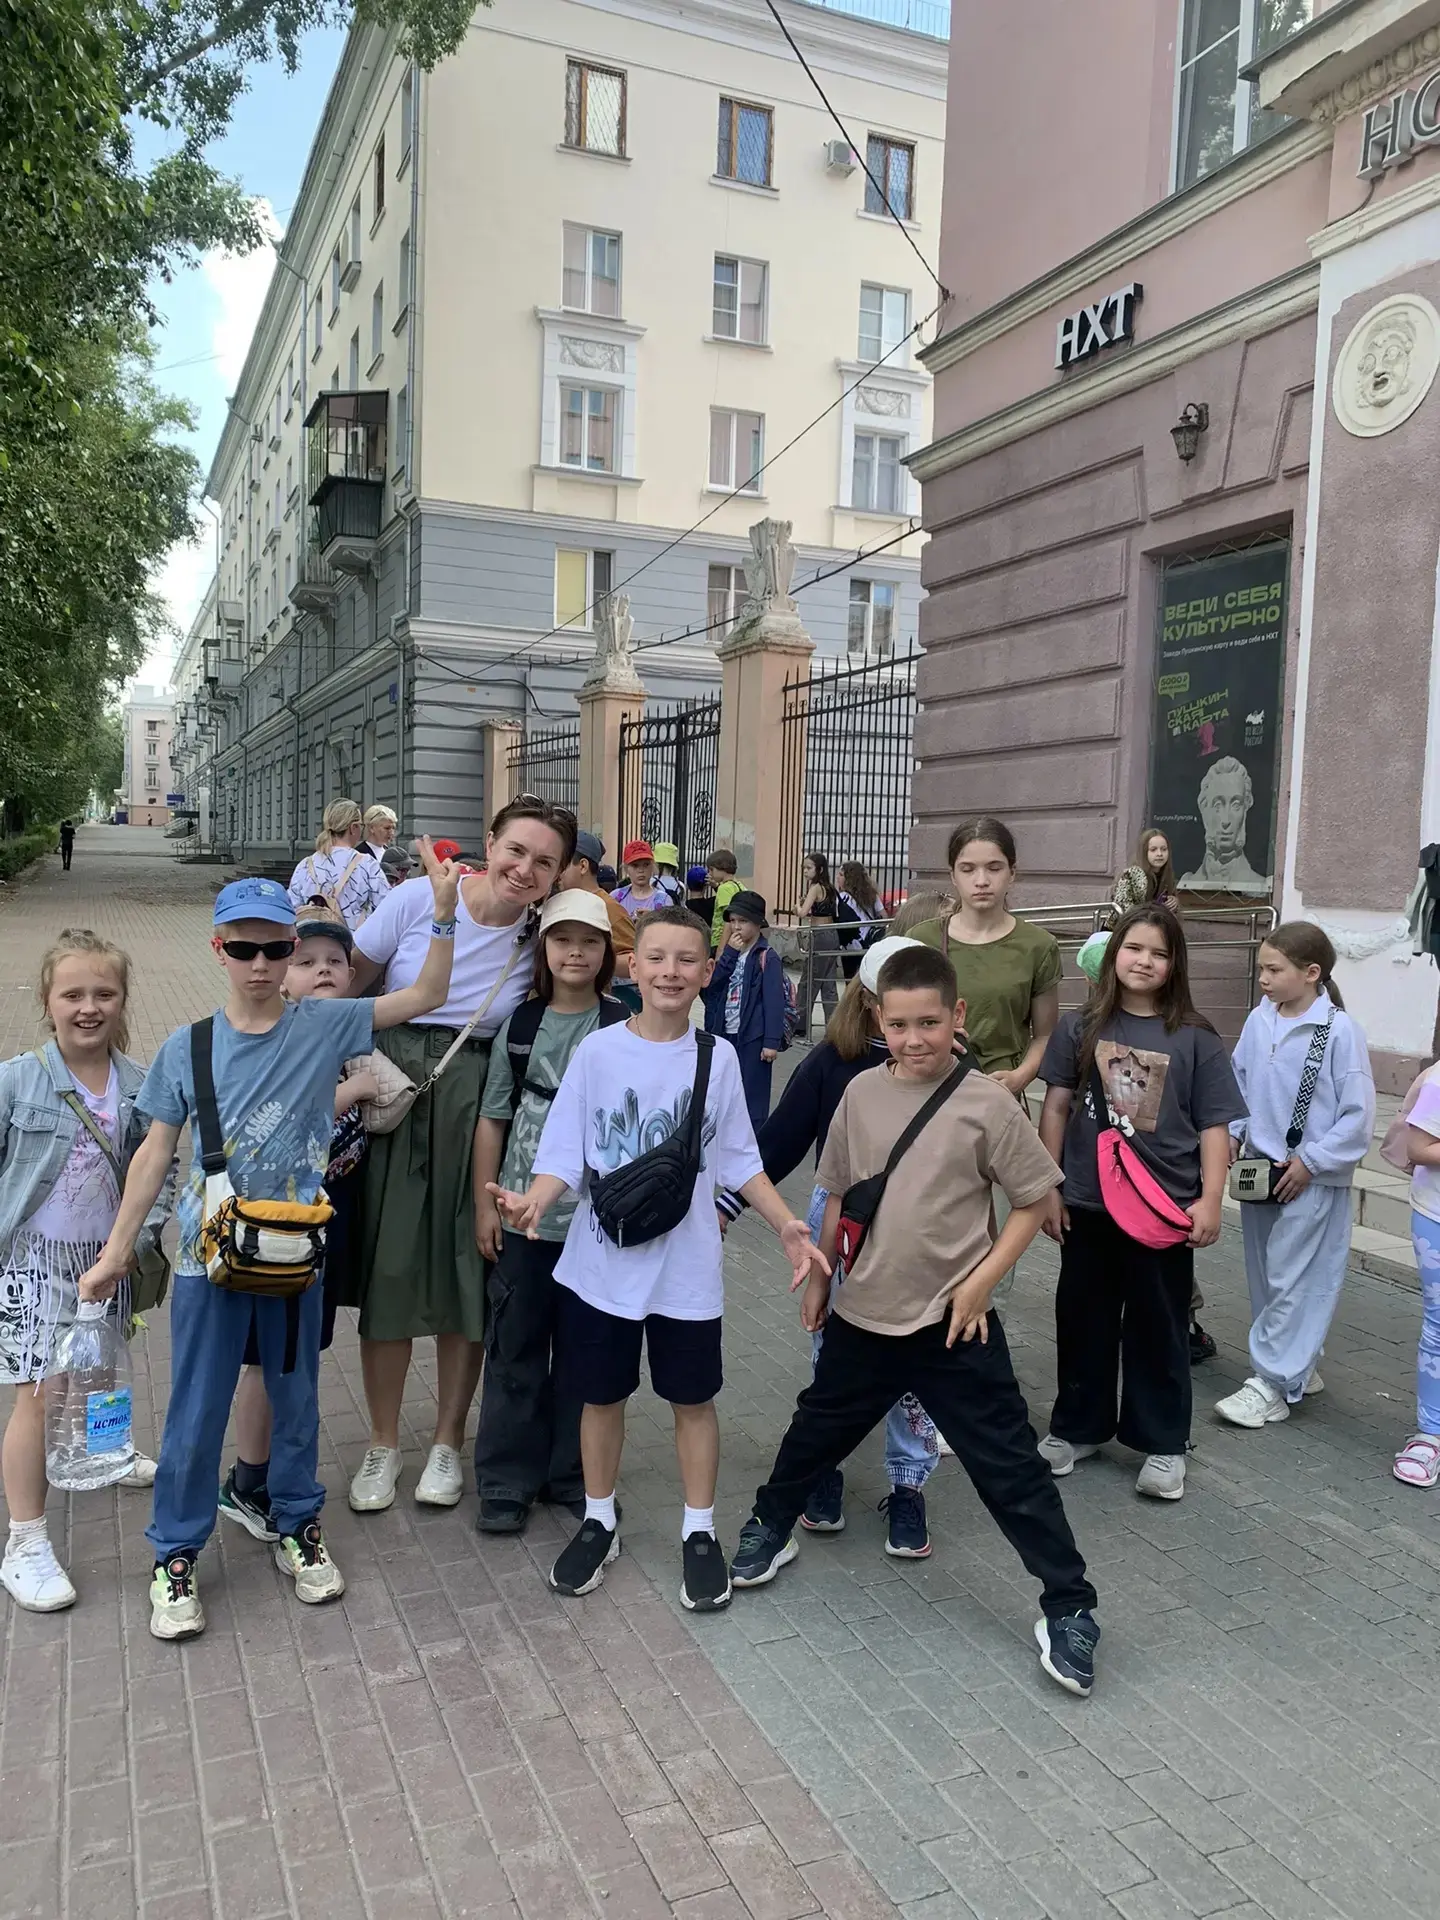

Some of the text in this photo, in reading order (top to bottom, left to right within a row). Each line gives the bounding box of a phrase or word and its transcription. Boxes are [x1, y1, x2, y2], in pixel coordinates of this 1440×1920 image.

[1055, 282, 1142, 370] НХТ
[1165, 582, 1282, 622] ВЕДИ СЕБЯ
[1163, 605, 1280, 642] КУЛЬТУРНО
[1168, 688, 1228, 720] ПУШКИН
[1168, 708, 1204, 728] СКАЯ
[1183, 708, 1229, 733] КАРТА
